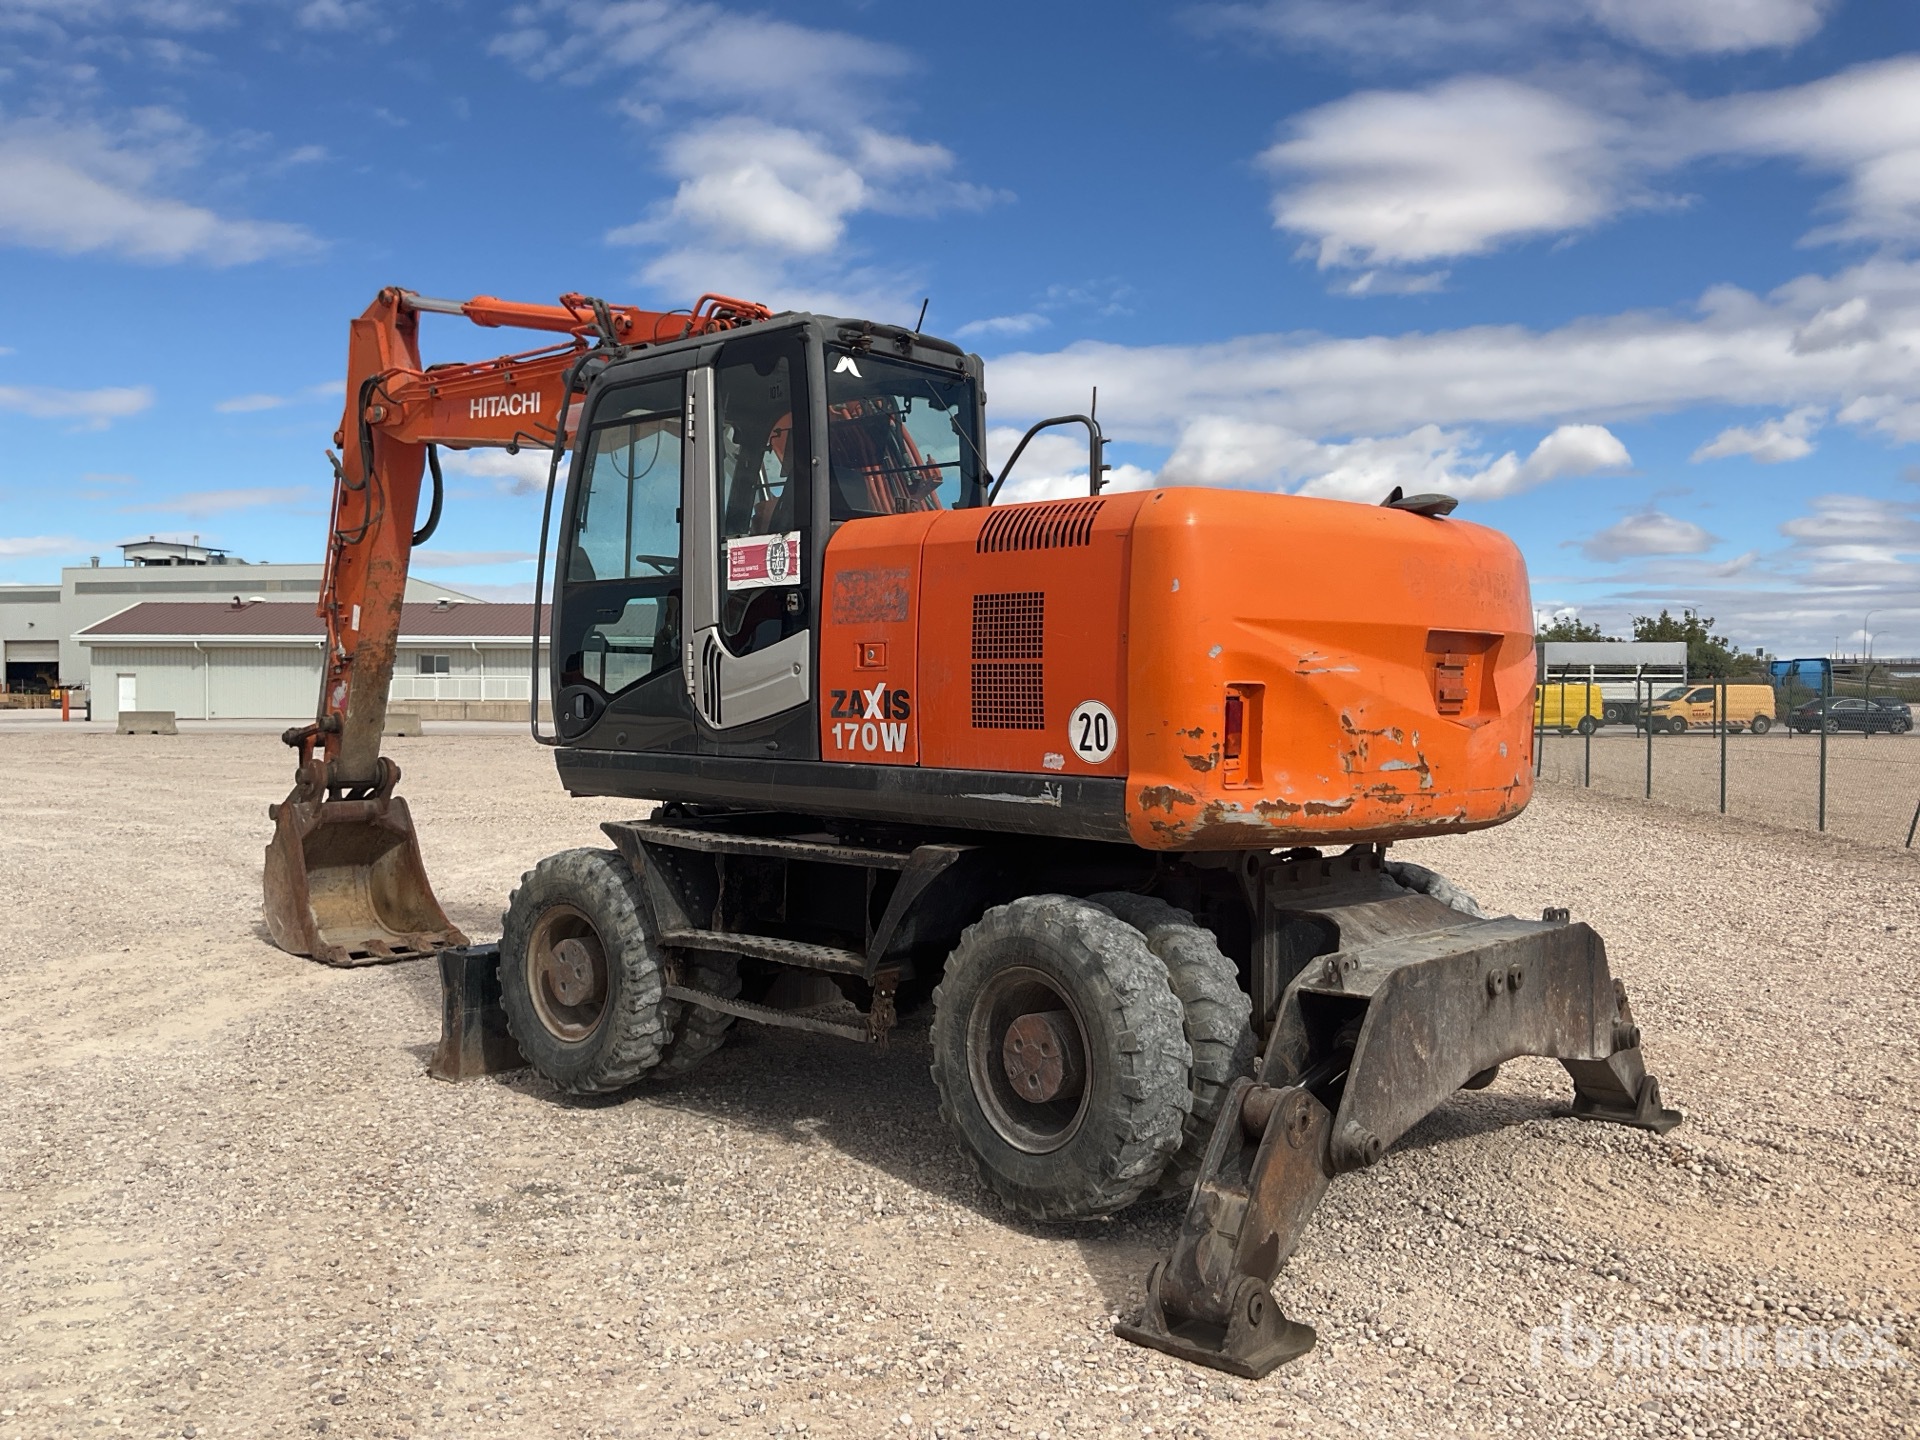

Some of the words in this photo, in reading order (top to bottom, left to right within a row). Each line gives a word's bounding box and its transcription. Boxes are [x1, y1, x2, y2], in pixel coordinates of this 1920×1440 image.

[470, 391, 541, 419] HITACHI
[831, 682, 910, 720] ZAXIS
[832, 722, 908, 752] 170W
[1078, 712, 1109, 752] 20
